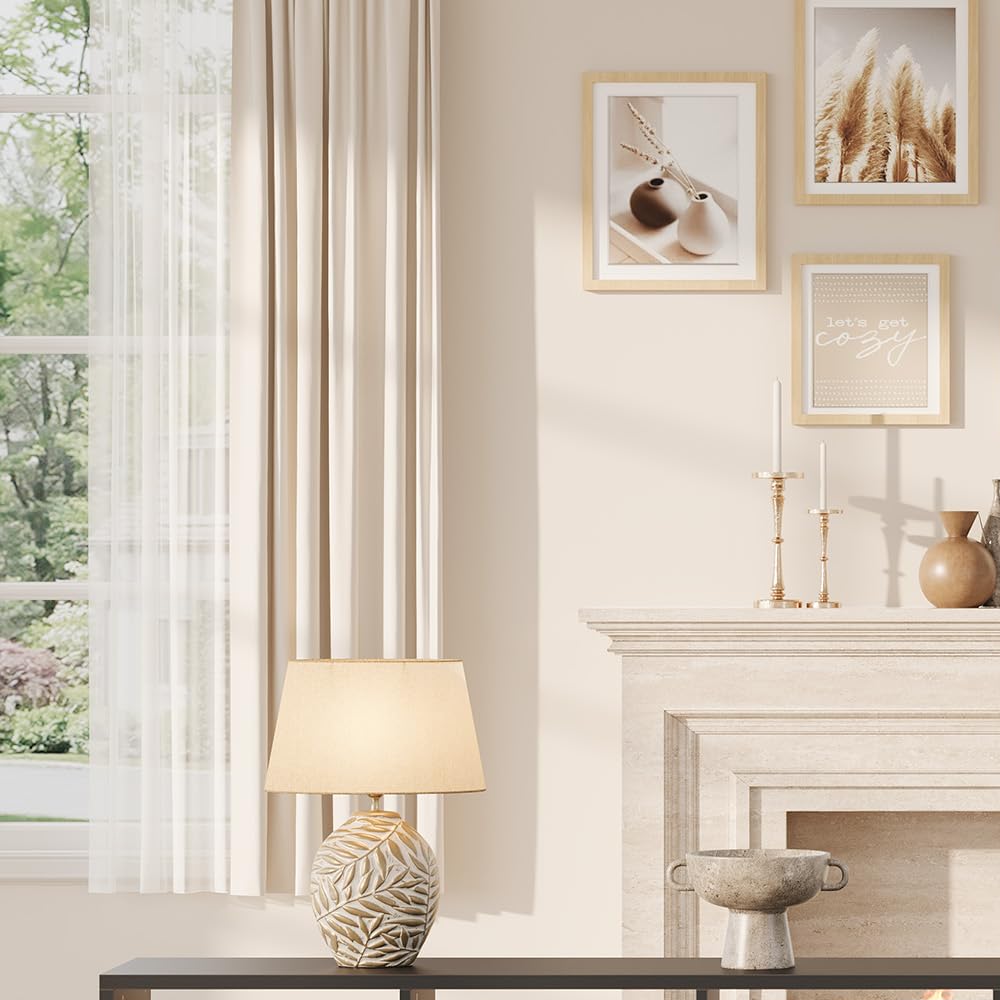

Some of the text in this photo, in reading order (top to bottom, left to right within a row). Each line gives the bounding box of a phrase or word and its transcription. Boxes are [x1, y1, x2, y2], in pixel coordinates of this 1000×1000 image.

[826, 317, 908, 329] let's get
[815, 328, 927, 367] cozy
